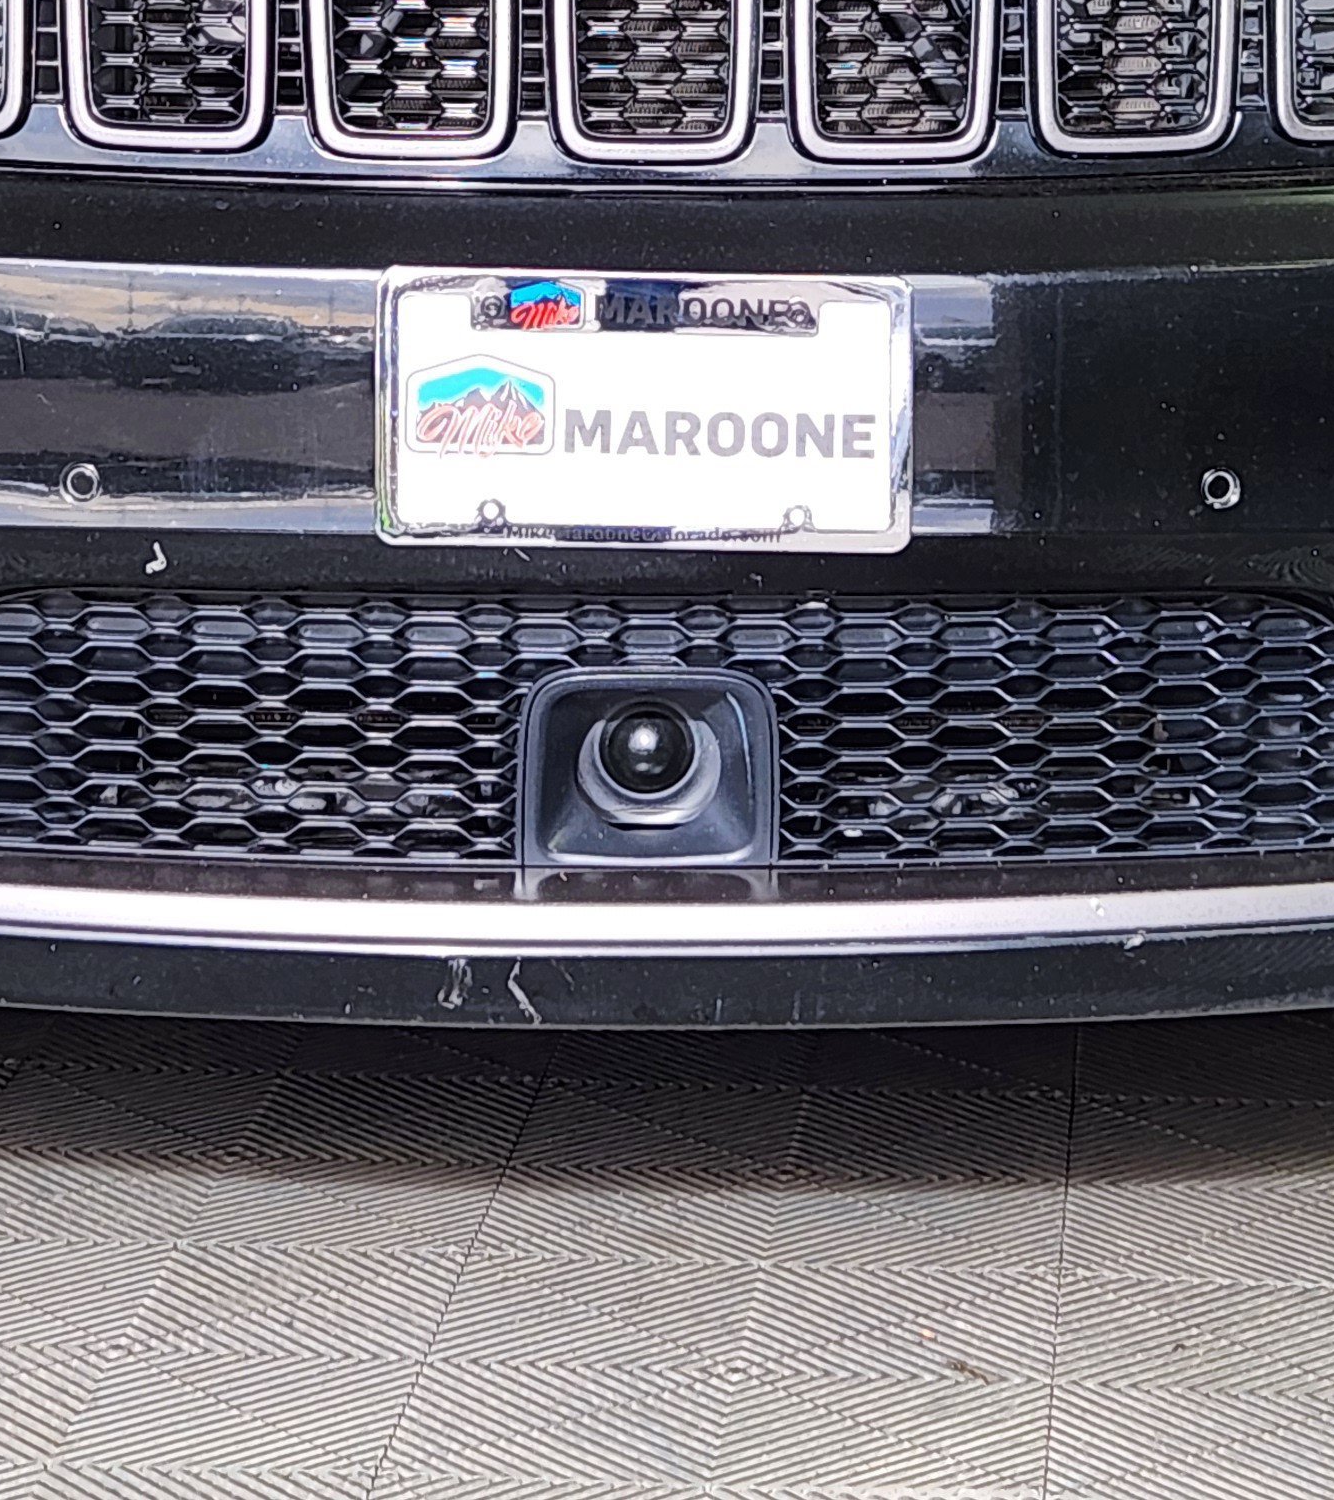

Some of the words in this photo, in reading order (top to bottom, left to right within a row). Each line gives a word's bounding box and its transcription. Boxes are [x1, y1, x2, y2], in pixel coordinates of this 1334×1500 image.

[510, 298, 580, 330] Mike
[595, 293, 794, 328] MAROONE
[417, 400, 544, 458] Mike
[564, 408, 876, 459] MAROONE
